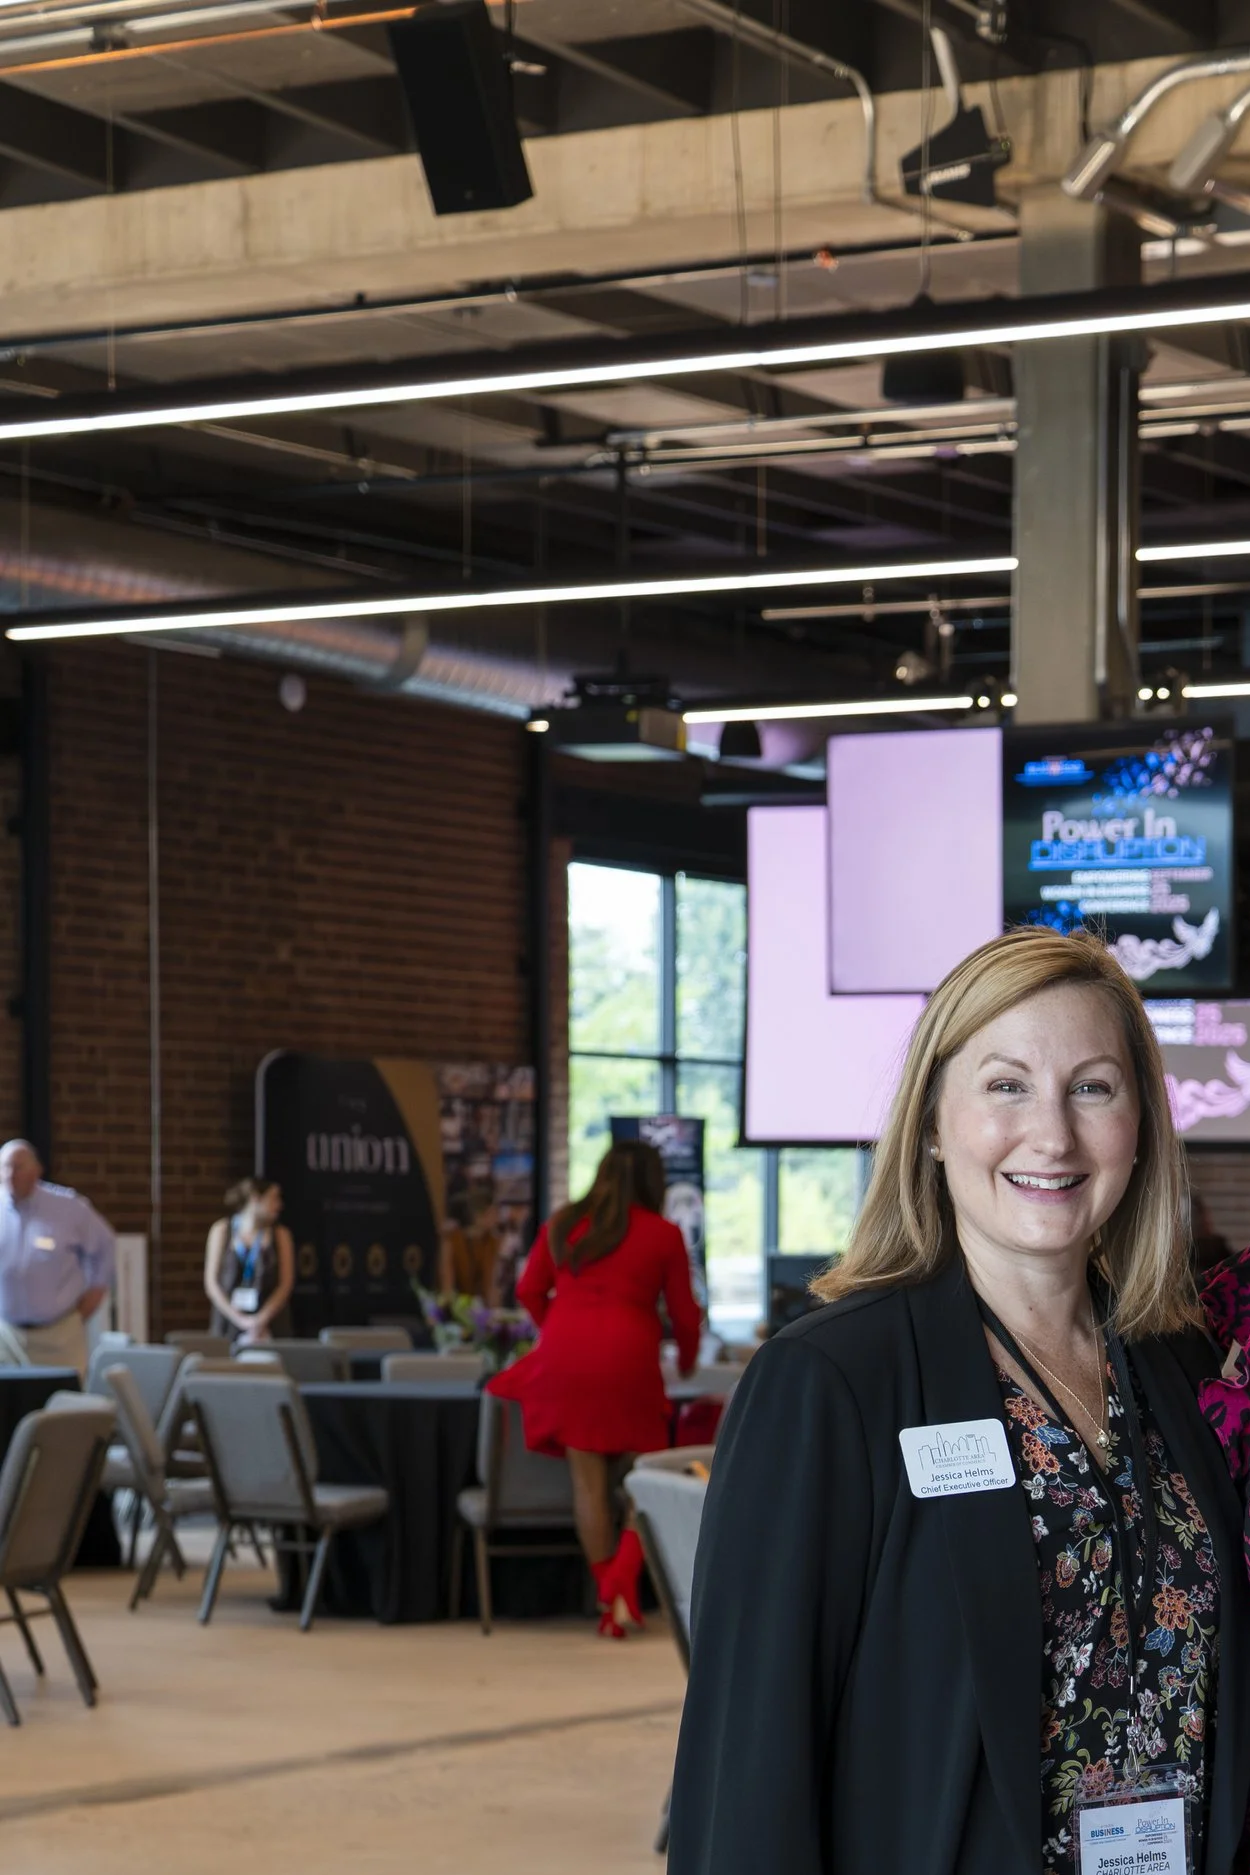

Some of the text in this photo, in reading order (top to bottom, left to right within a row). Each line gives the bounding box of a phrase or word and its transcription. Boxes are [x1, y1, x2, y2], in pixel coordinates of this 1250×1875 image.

[1042, 807, 1177, 842] Power In
[1030, 836, 1207, 861] DISRUPTION
[306, 1122, 410, 1174] union
[931, 1468, 994, 1482] Jessica Helms
[920, 1478, 1008, 1494] Chief Executive Officer
[1137, 1816, 1169, 1827] Power In
[1090, 1826, 1125, 1838] BUSINESS
[1098, 1851, 1167, 1869] Jessica Helms
[1147, 1862, 1170, 1873] AREA
